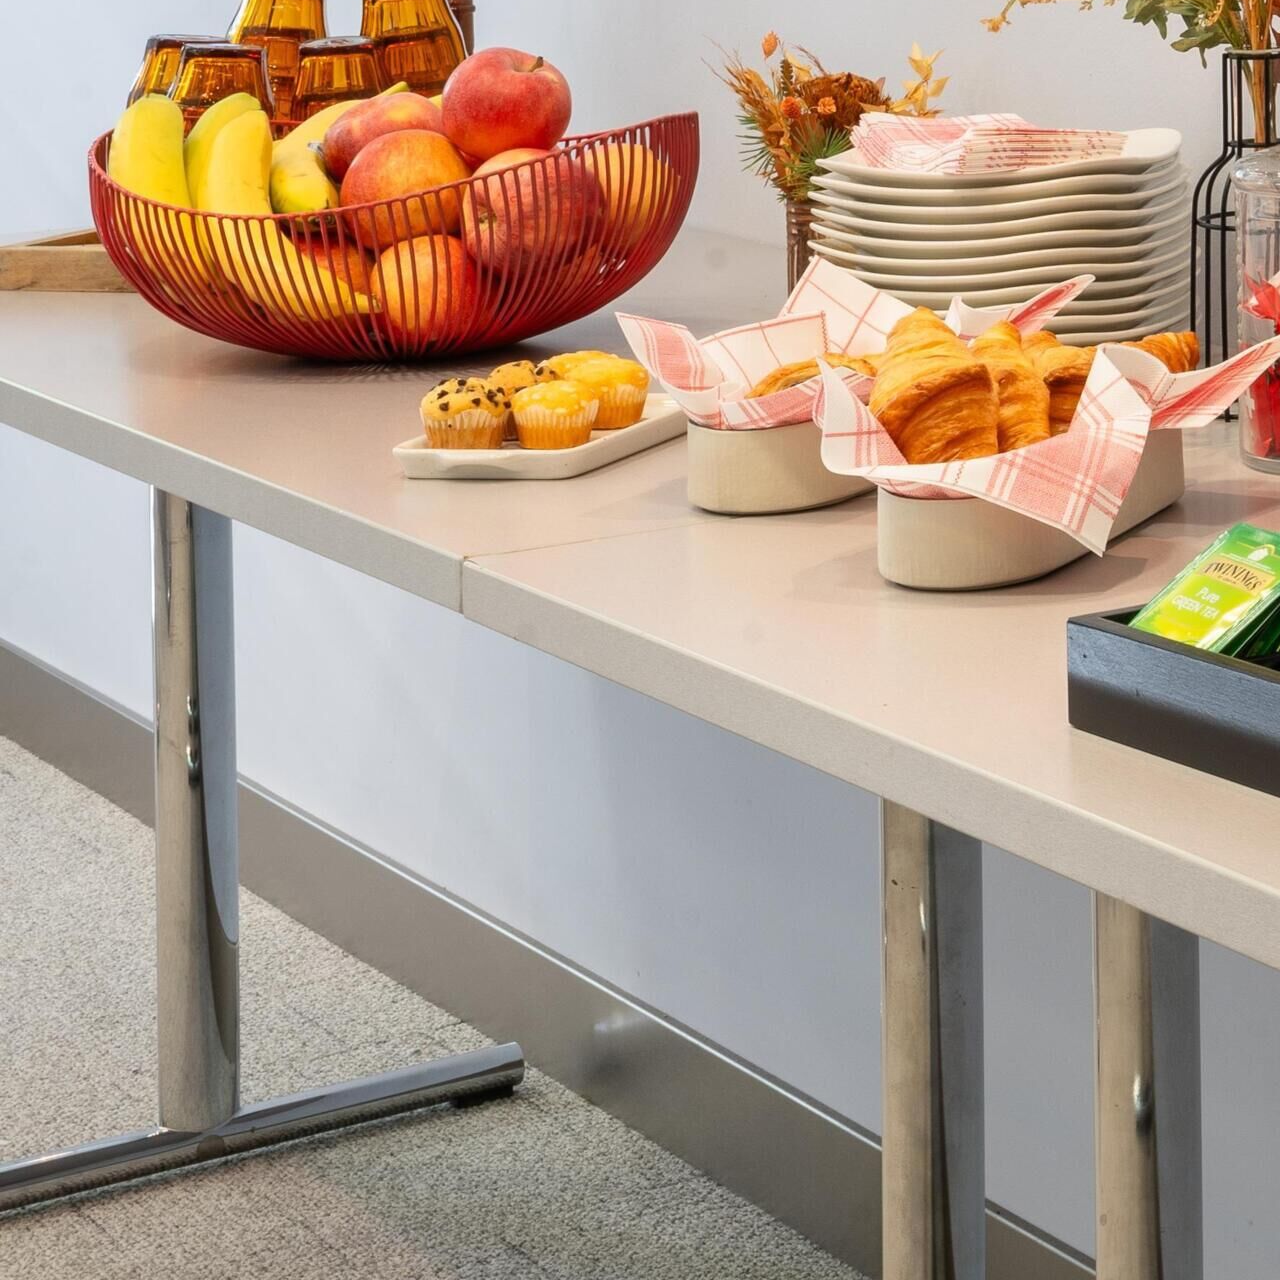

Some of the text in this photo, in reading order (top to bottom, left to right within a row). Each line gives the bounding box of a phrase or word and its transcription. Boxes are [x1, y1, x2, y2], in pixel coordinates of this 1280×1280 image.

[1204, 562, 1262, 590] TWININGS
[1172, 595, 1219, 619] GREEN TEA
[1196, 587, 1221, 603] Pure
